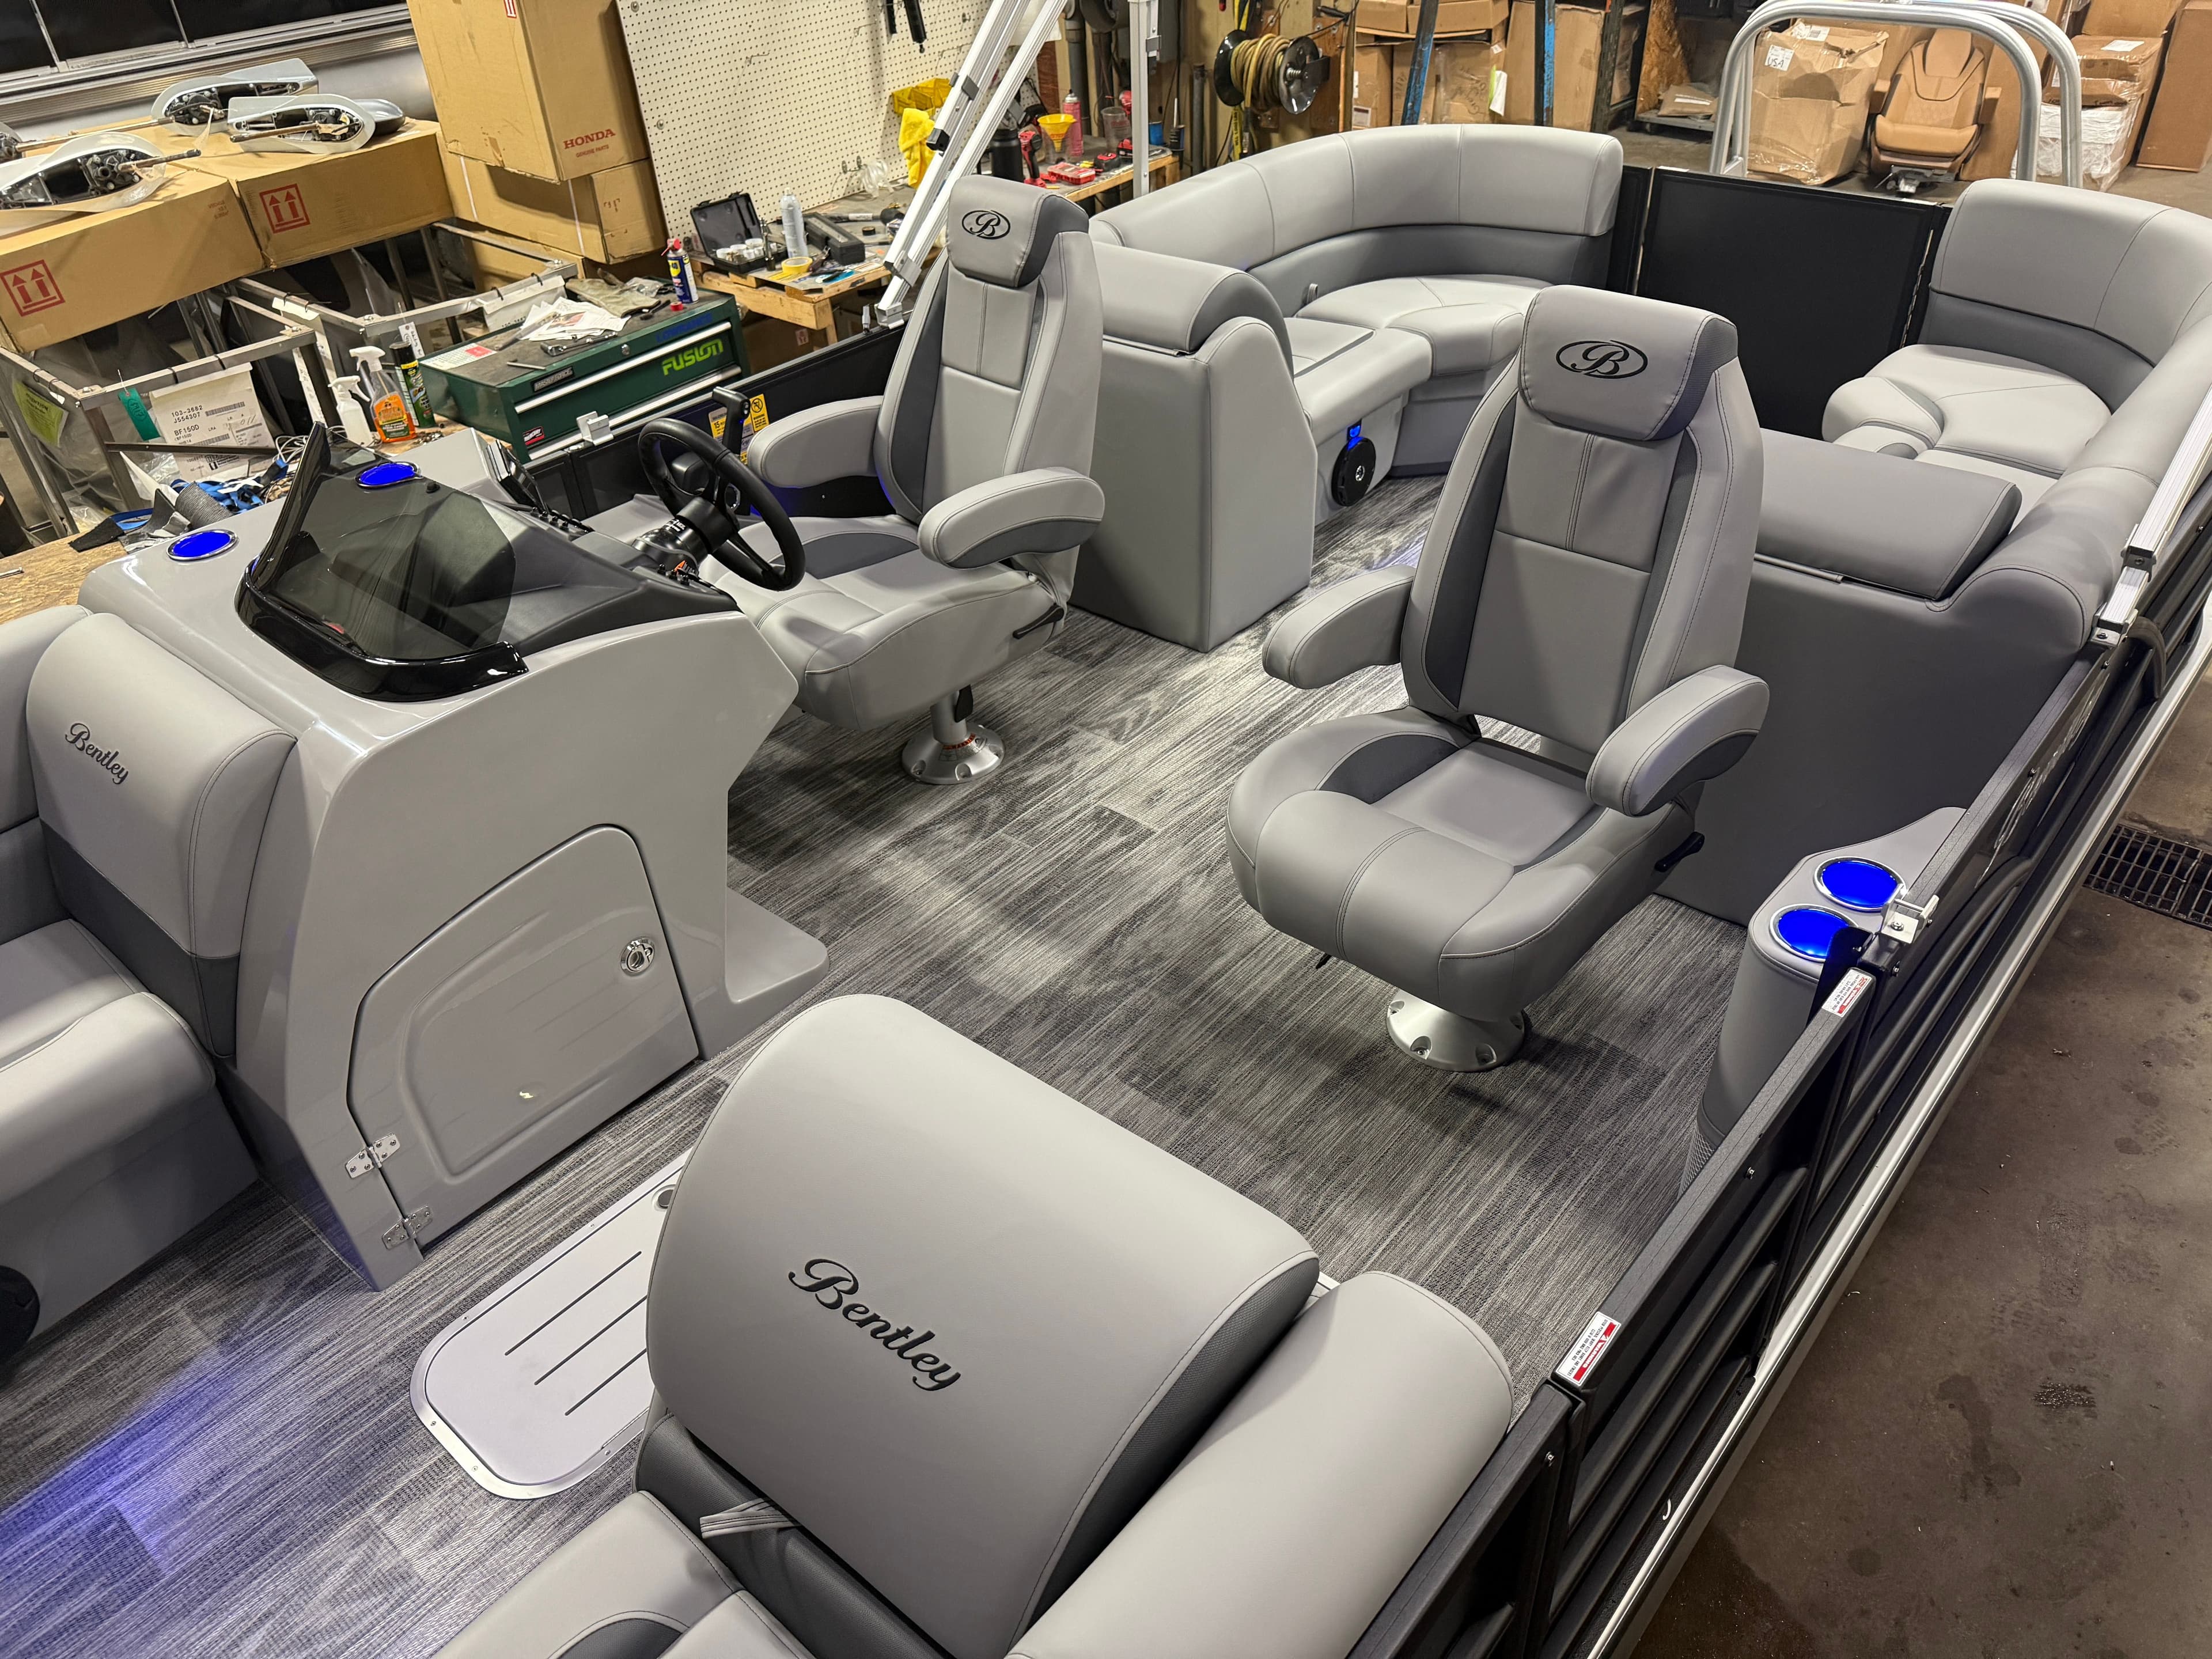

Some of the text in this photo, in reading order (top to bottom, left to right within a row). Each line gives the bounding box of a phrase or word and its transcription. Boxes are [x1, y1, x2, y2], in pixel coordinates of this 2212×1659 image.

[563, 128, 616, 149] HONDA
[662, 339, 724, 376] FUSION
[174, 425, 199, 436] BF150D
[65, 722, 128, 785] Bentley
[788, 1259, 961, 1392] Bentley
[1582, 1340, 1604, 1368] WARNING
